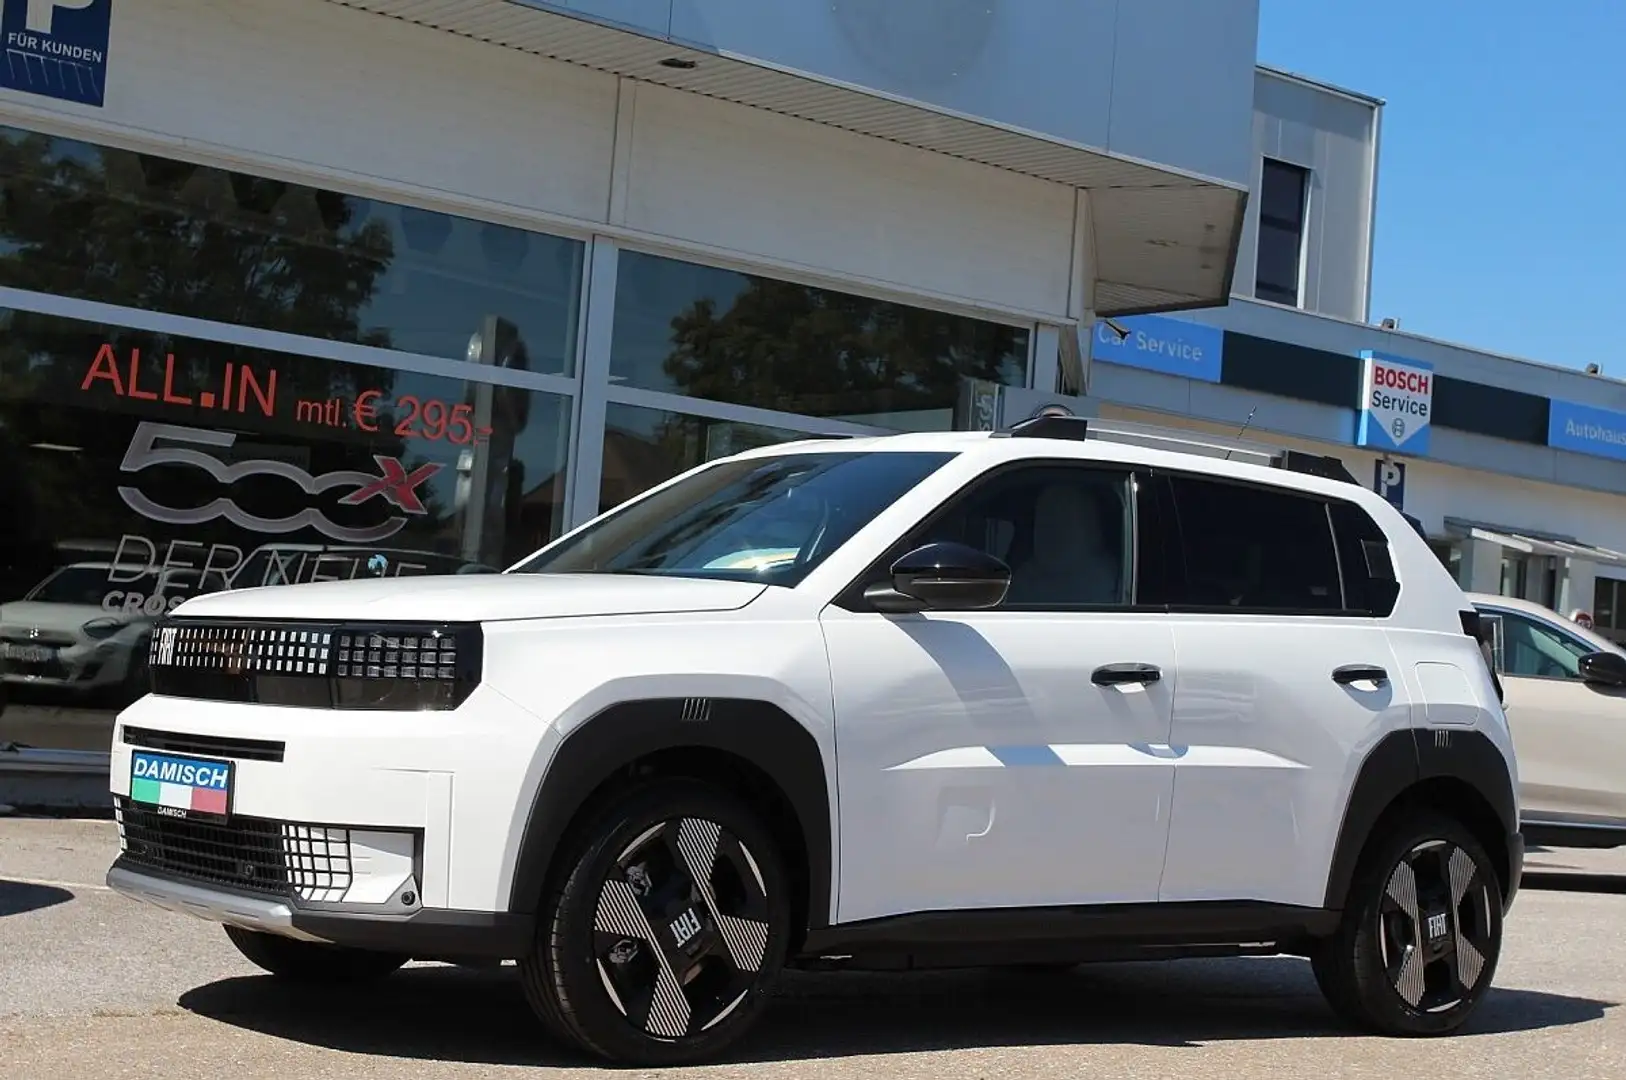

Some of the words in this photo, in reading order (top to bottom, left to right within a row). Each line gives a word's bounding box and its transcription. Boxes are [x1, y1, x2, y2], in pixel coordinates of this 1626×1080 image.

[8, 32, 37, 49] FÜR
[41, 39, 102, 63] KUNDEN
[1136, 330, 1203, 362] Service
[1374, 365, 1429, 395] BOSCH
[296, 398, 347, 428] mtl.
[1371, 389, 1428, 417] Service
[107, 534, 243, 591] DER
[133, 758, 228, 788] DAMISCH
[157, 806, 186, 818] DAMISCH
[670, 907, 701, 948] FIAT
[1428, 913, 1446, 939] FIAT
